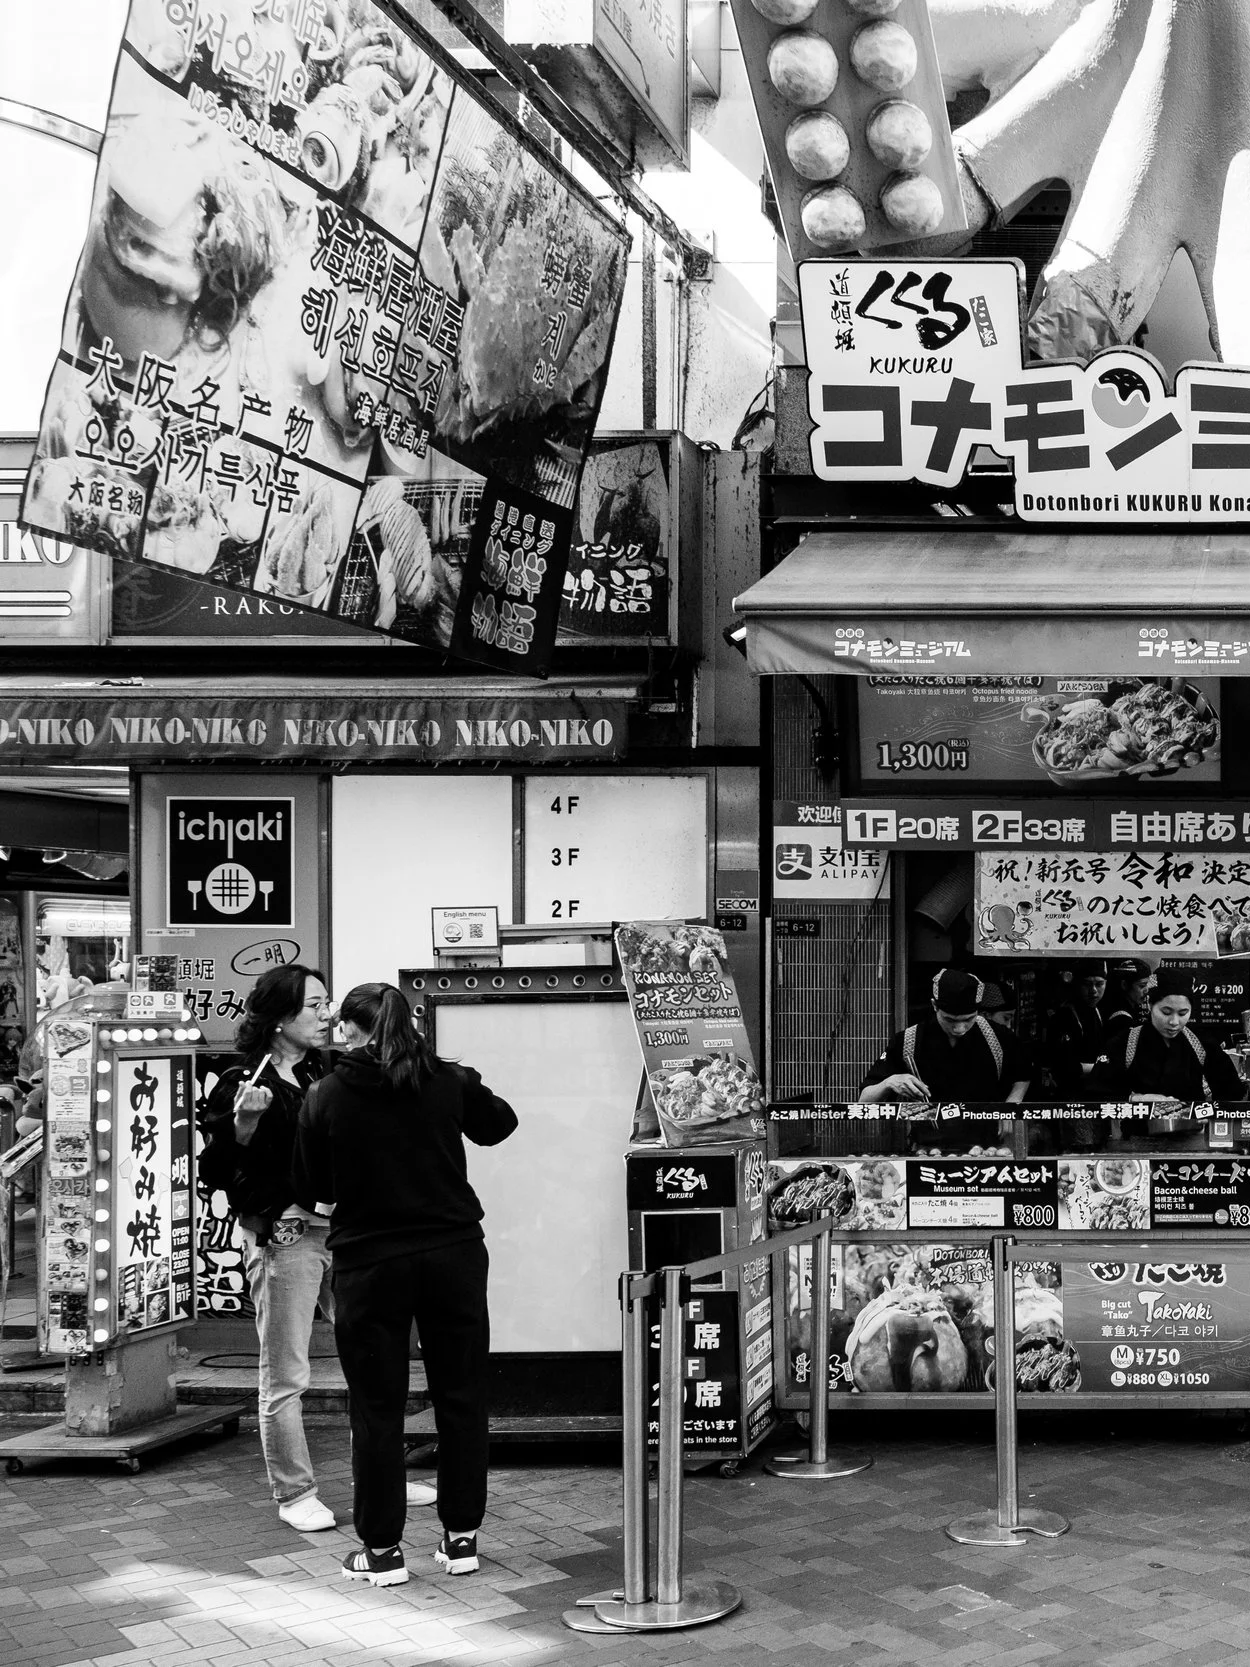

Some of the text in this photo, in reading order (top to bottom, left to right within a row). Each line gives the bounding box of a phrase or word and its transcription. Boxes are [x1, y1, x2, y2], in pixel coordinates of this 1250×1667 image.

[311, 203, 467, 366] 海鮮居酒屋
[829, 267, 857, 353] 道頓堀
[869, 356, 954, 375] KUKURU
[75, 415, 301, 515] 오오사까특산품
[1023, 494, 1119, 512] Dotonbori
[1127, 494, 1202, 512] KUKURU
[834, 635, 972, 658] コナモンミュージアム
[876, 688, 906, 697] Takoyaki
[972, 687, 1038, 697] Octopus fried noodle
[109, 717, 267, 745] NIKO-NIKO
[283, 718, 441, 748] NIKO-NIKO
[455, 718, 614, 748] NIKO-NIKO
[878, 741, 968, 770] 1,300円
[854, 811, 890, 839] 1F
[898, 816, 960, 842] 20席
[976, 813, 1021, 840] 2F
[1024, 818, 1087, 843] 33席
[820, 868, 880, 880] ALIPAY
[718, 899, 757, 910] SECOM
[443, 911, 467, 920] English
[633, 971, 718, 985] KONAMON SET
[635, 981, 734, 1009] コナモンセット
[644, 1030, 690, 1047] 1,300円
[770, 1103, 1017, 1121] たこ焼 Meister 実演中 PhotoSpot
[1022, 1110, 1052, 1120] たこ焼
[1052, 1108, 1100, 1119] Meister
[1100, 1103, 1149, 1119] 実演中
[126, 1061, 162, 1258] お好み焼
[919, 1164, 1054, 1185] ミュージアムセット
[933, 1185, 965, 1193] Museum
[966, 1185, 979, 1193] set
[1220, 1186, 1237, 1195] ball
[1013, 1204, 1055, 1227] ¥800
[172, 1227, 190, 1238] OPEN
[172, 1237, 189, 1246] 11:00
[172, 1250, 190, 1260] CLOSE
[934, 1247, 989, 1263] DOTONBORI
[176, 1291, 192, 1303] B1F
[1101, 1300, 1132, 1310] Big cut
[1116, 1347, 1181, 1366] M ¥750
[1127, 1373, 1156, 1385] ¥880
[1174, 1373, 1210, 1385] ¥1050
[718, 1436, 738, 1444] store
